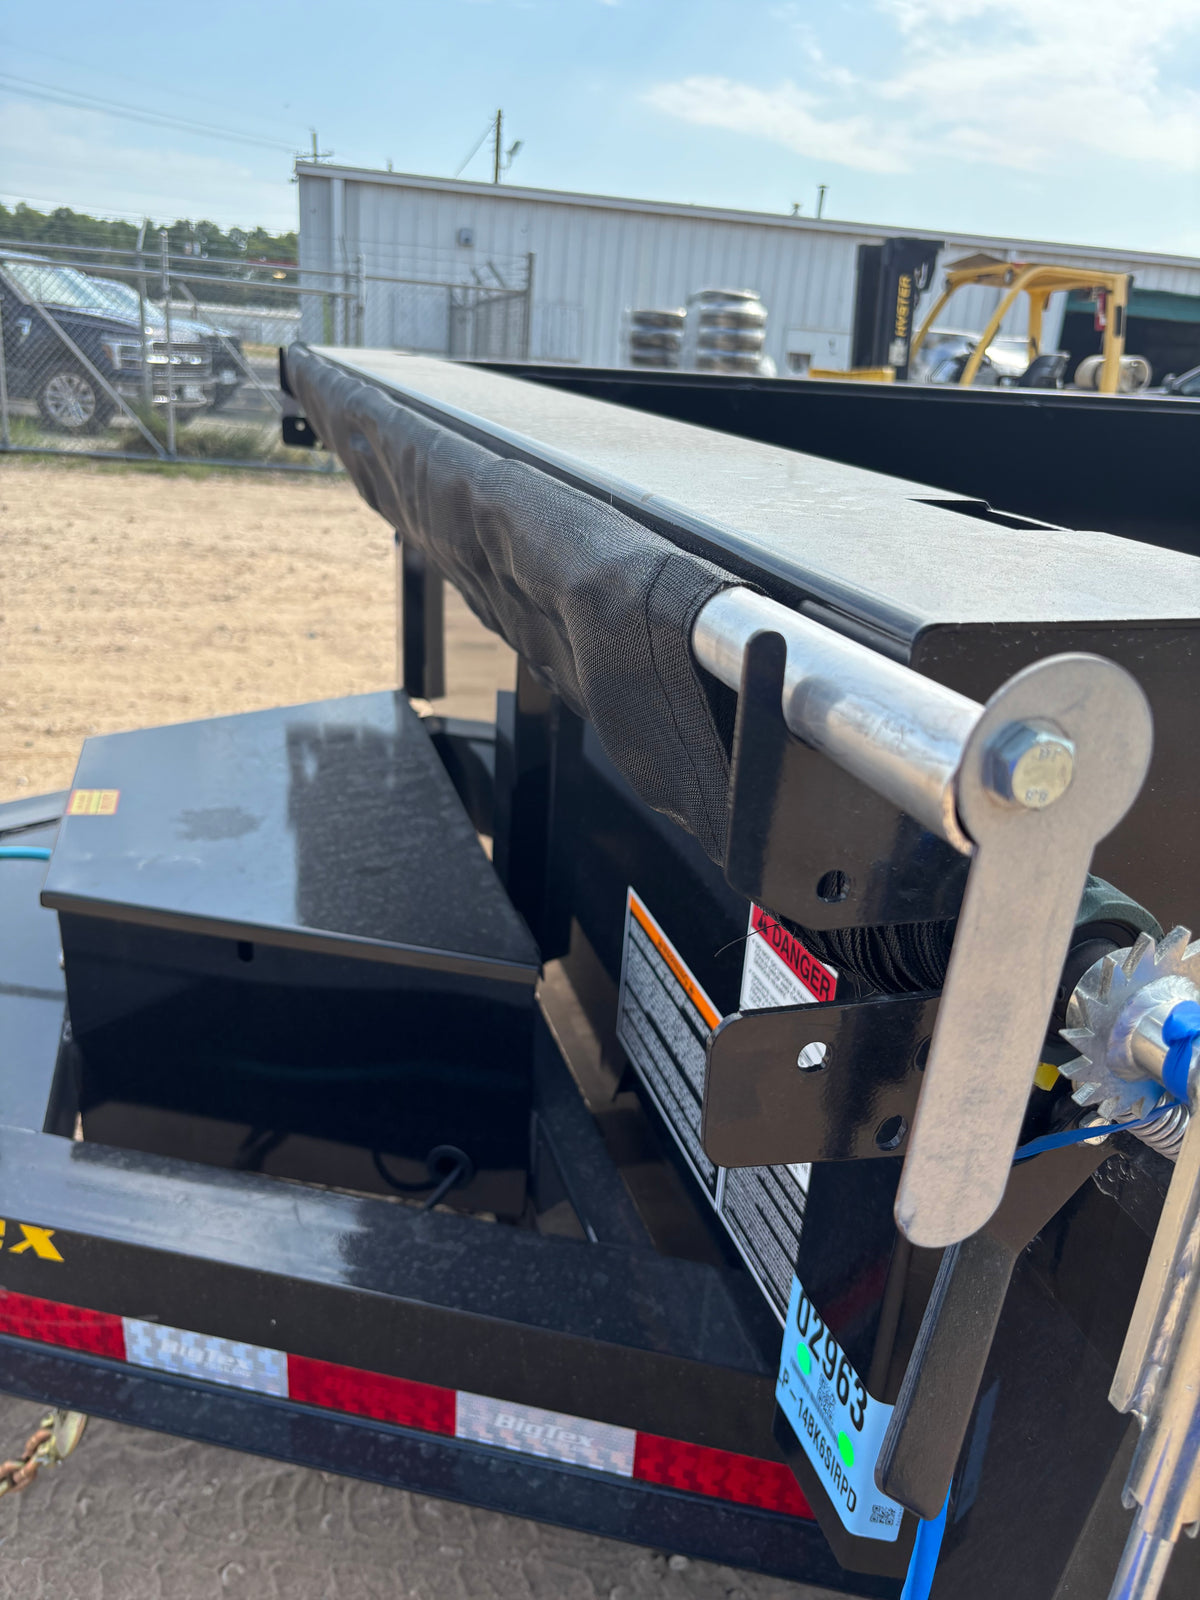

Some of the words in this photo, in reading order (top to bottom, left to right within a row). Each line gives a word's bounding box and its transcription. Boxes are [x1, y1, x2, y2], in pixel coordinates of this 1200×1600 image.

[895, 275, 911, 337] HYSTER
[772, 924, 831, 1001] DANGER
[797, 1289, 867, 1432] 02963
[494, 1412, 595, 1447] BigTex
